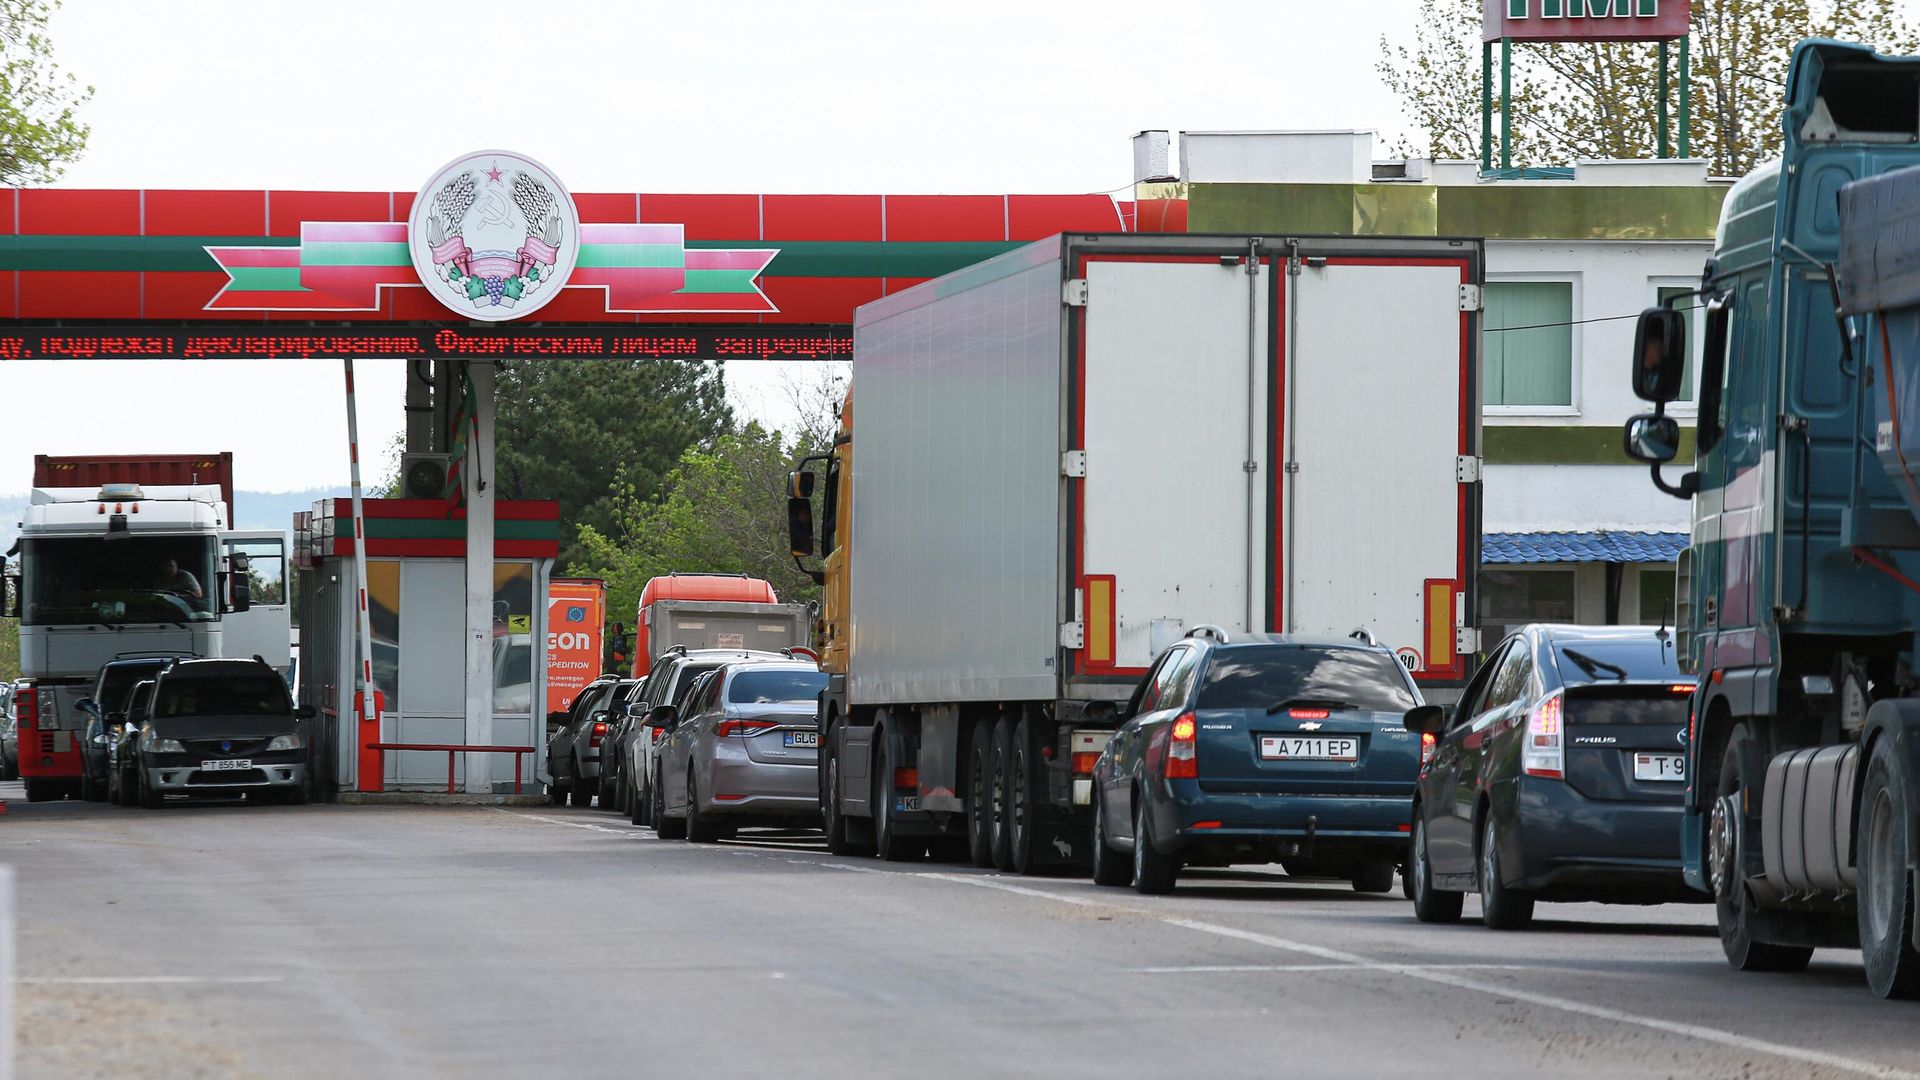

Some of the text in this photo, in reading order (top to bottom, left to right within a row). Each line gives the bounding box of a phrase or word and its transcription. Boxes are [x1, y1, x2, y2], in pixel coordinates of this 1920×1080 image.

[41, 337, 174, 357] подлежат
[183, 337, 426, 359] декларированию.
[434, 329, 603, 353] Физическим
[611, 337, 697, 357] лицам
[1400, 654, 1415, 670] 80
[795, 733, 816, 744] GLG
[1278, 740, 1351, 756] A 711 EP
[1655, 758, 1684, 774] T 9
